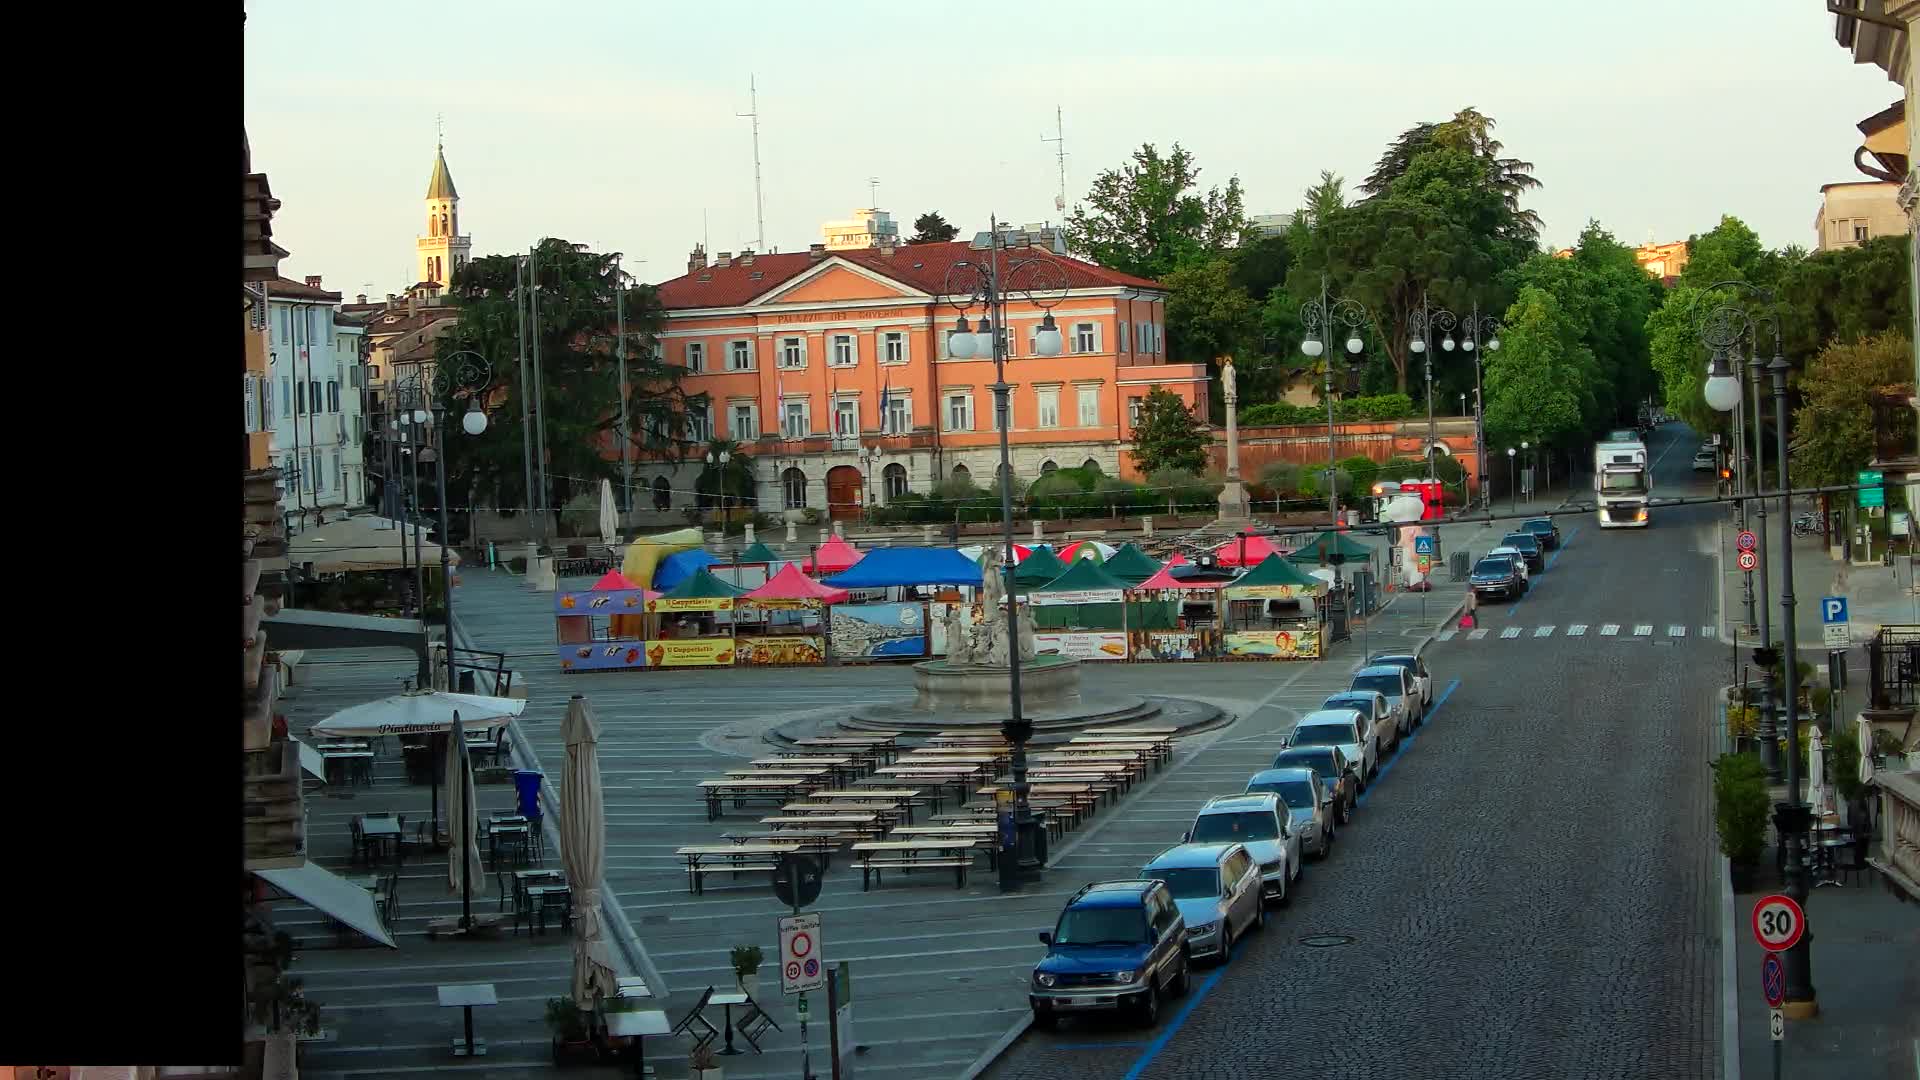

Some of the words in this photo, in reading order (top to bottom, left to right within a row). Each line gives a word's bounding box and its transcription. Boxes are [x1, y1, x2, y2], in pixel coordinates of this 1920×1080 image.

[1742, 556, 1753, 566] 20
[1827, 601, 1842, 621] P
[1763, 909, 1791, 936] 30
